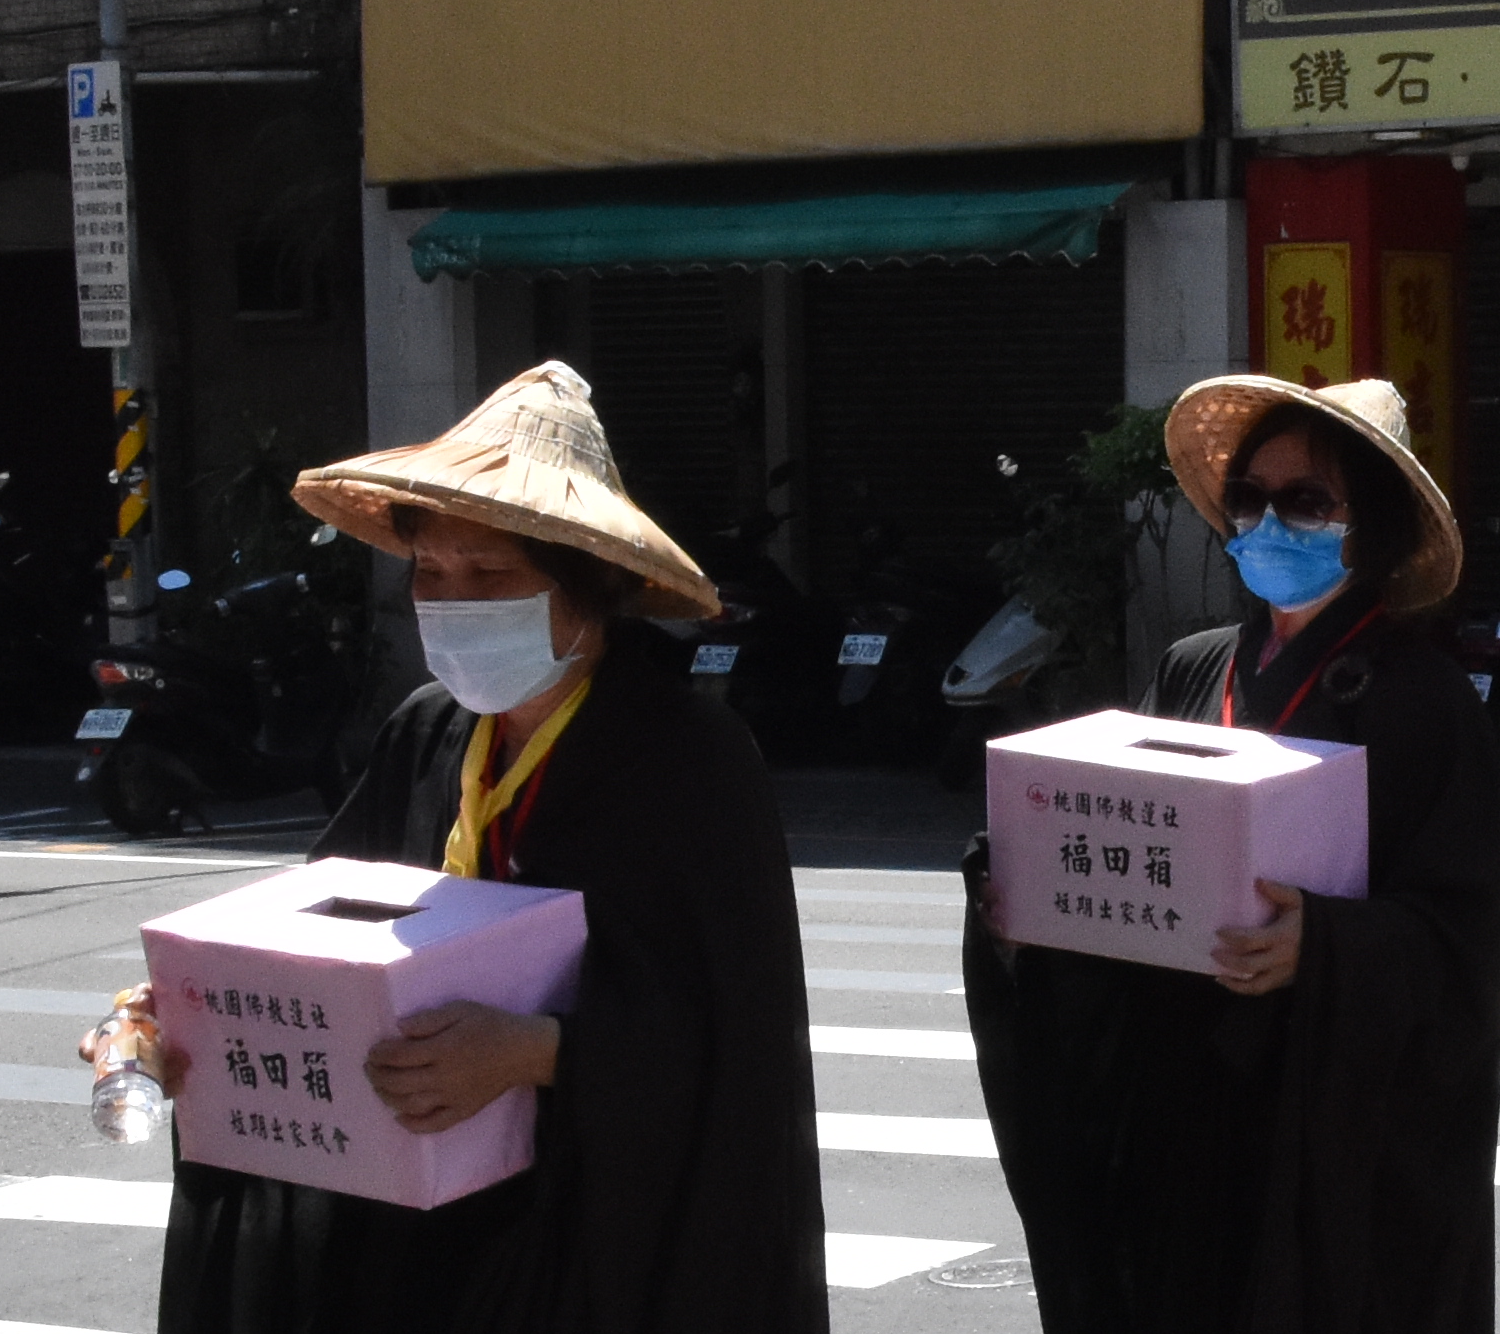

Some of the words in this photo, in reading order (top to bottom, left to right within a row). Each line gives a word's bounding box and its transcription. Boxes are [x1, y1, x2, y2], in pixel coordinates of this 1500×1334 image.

[73, 72, 91, 117] P
[1060, 833, 1173, 889] 福田箱
[225, 1037, 334, 1104] 福田箱
